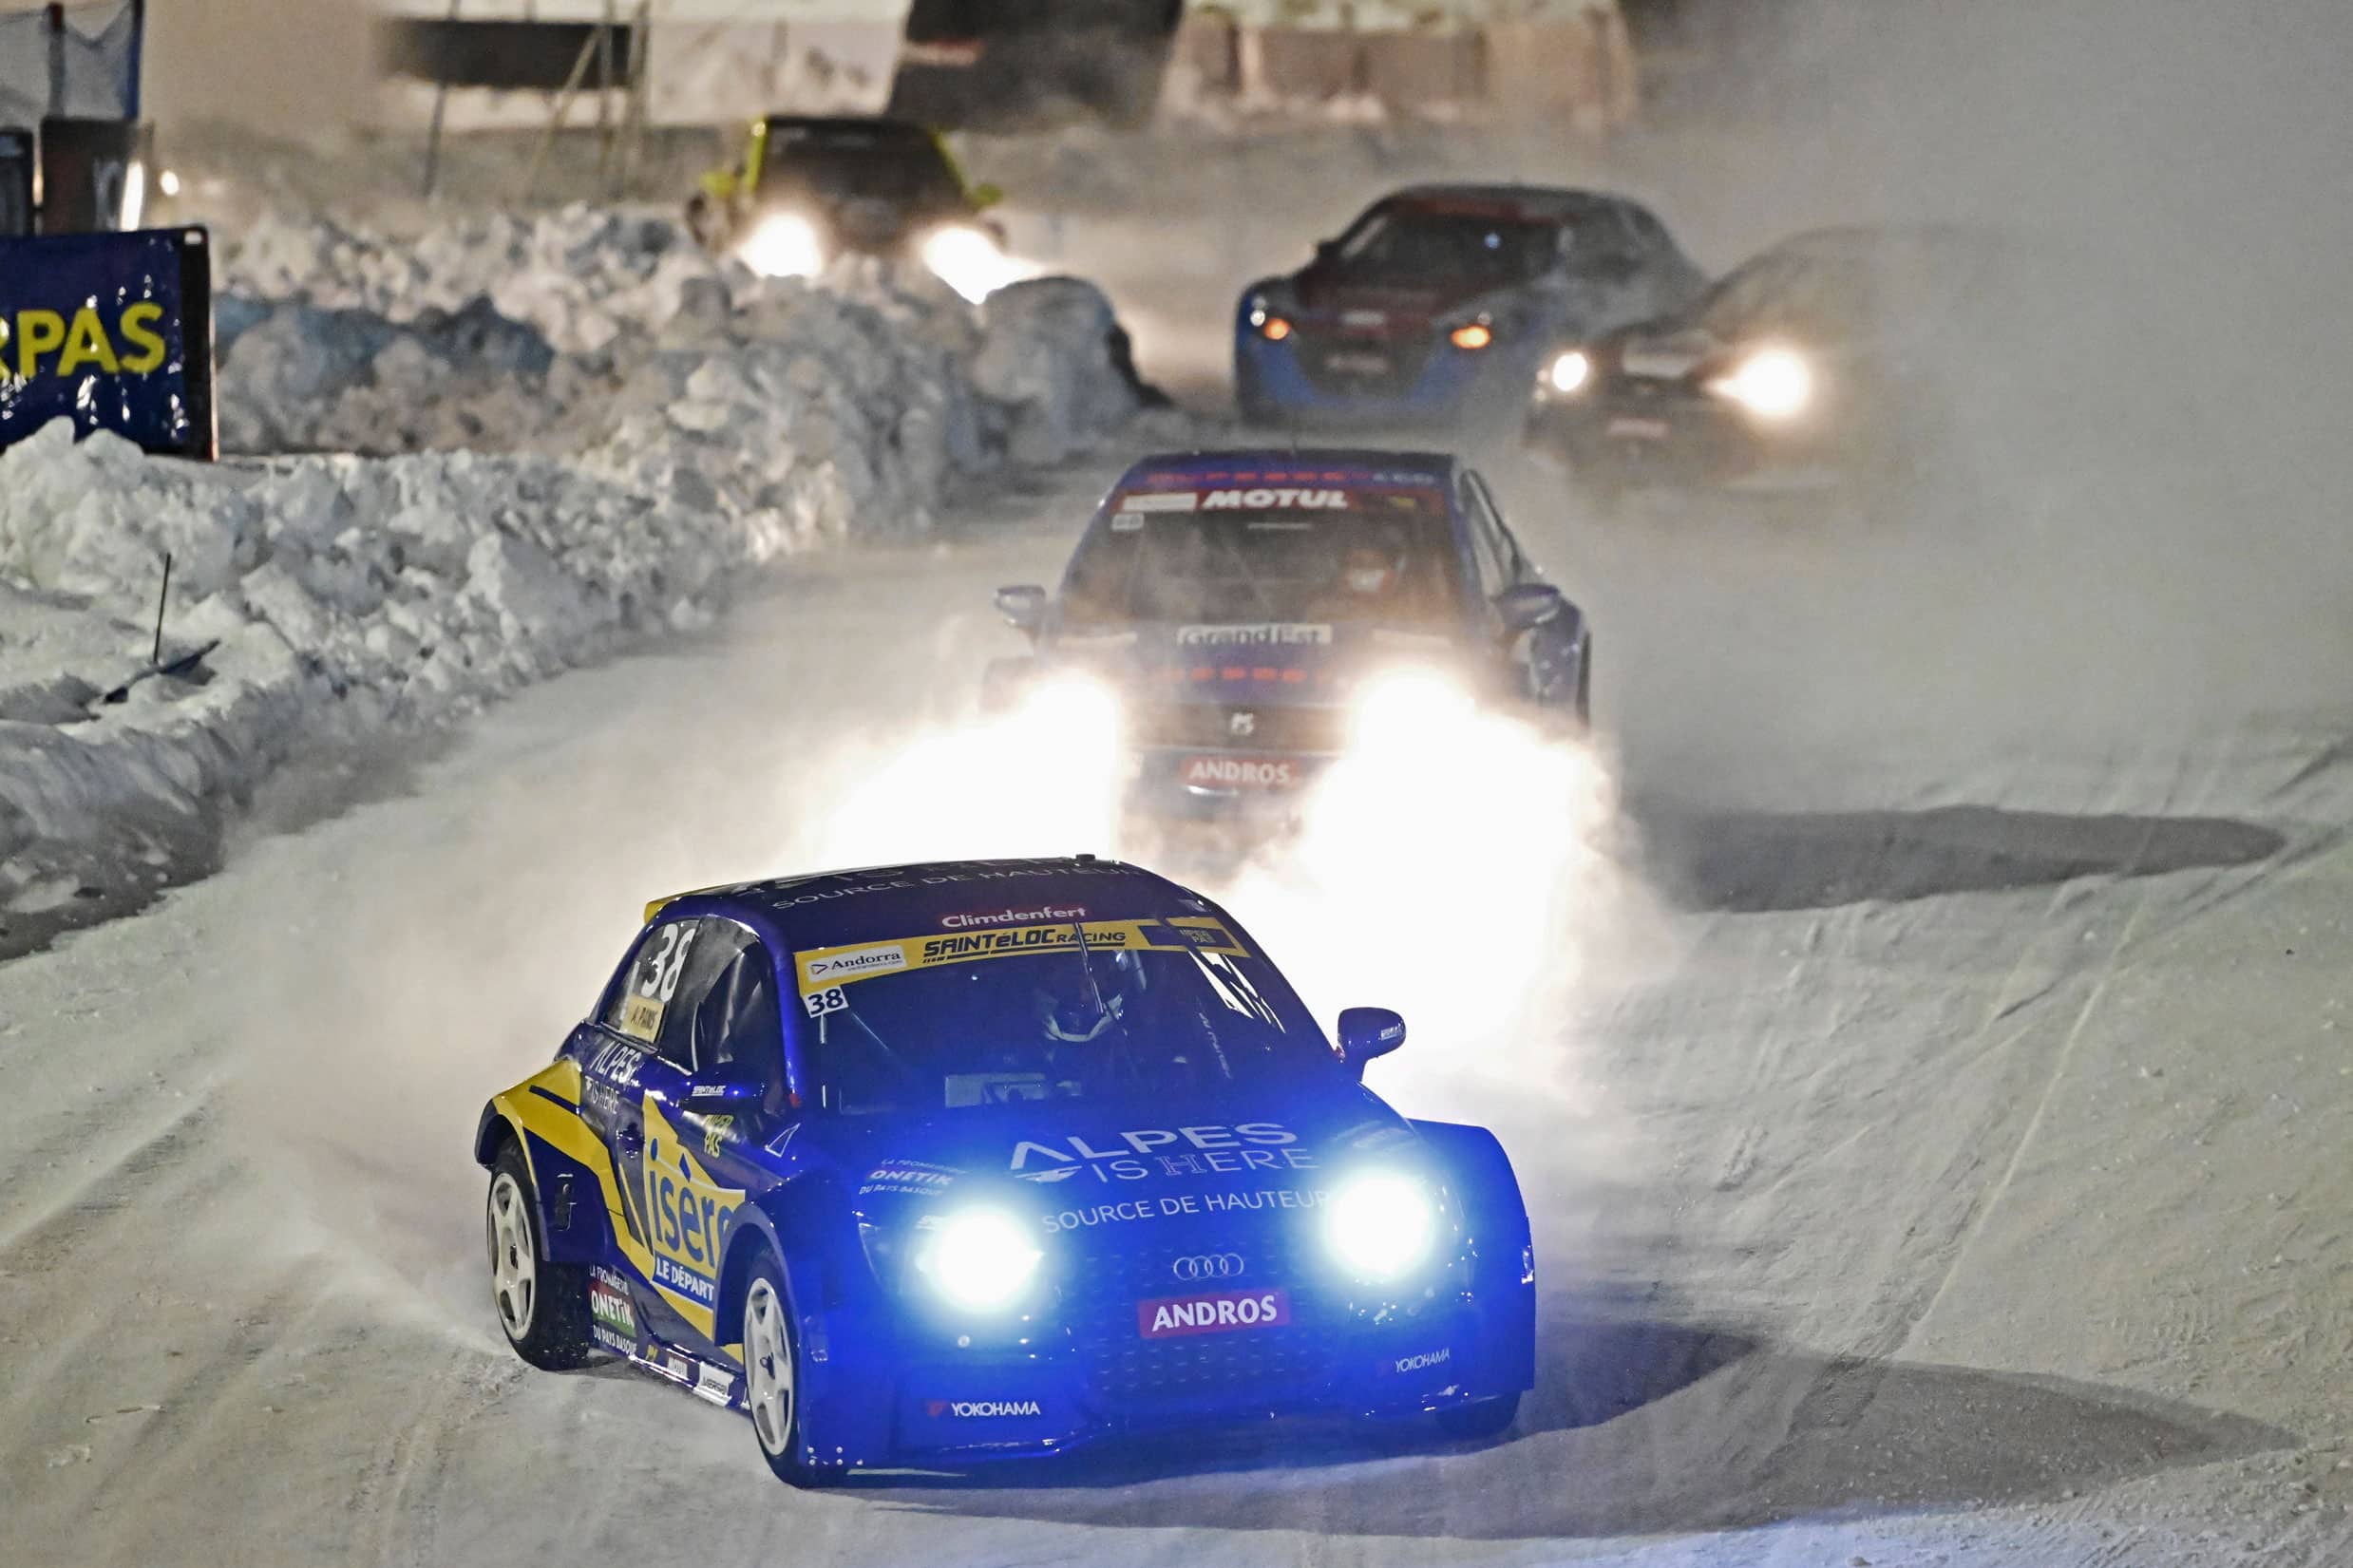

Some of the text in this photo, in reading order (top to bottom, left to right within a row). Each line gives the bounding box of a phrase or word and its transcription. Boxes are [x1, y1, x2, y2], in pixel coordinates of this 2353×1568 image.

[0, 302, 165, 378] PAS
[1202, 489, 1349, 510] MOTUL
[1189, 761, 1292, 784] ANDROS
[771, 880, 915, 909] SOURCE
[941, 906, 1087, 930] Climdenfert
[641, 923, 695, 1002] 38
[831, 952, 901, 970] Andorra
[807, 989, 844, 1015] 38
[589, 1040, 643, 1085] ALPES
[1010, 1123, 1299, 1170] ALPES
[1042, 1201, 1155, 1234] SOURCE
[1159, 1196, 1200, 1216] DE
[655, 1257, 714, 1302] LE DÉPART
[1152, 1294, 1278, 1332] ANDROS
[1395, 1348, 1451, 1373] YOKOHAMA
[951, 1401, 1041, 1418] YOKOHAMA
